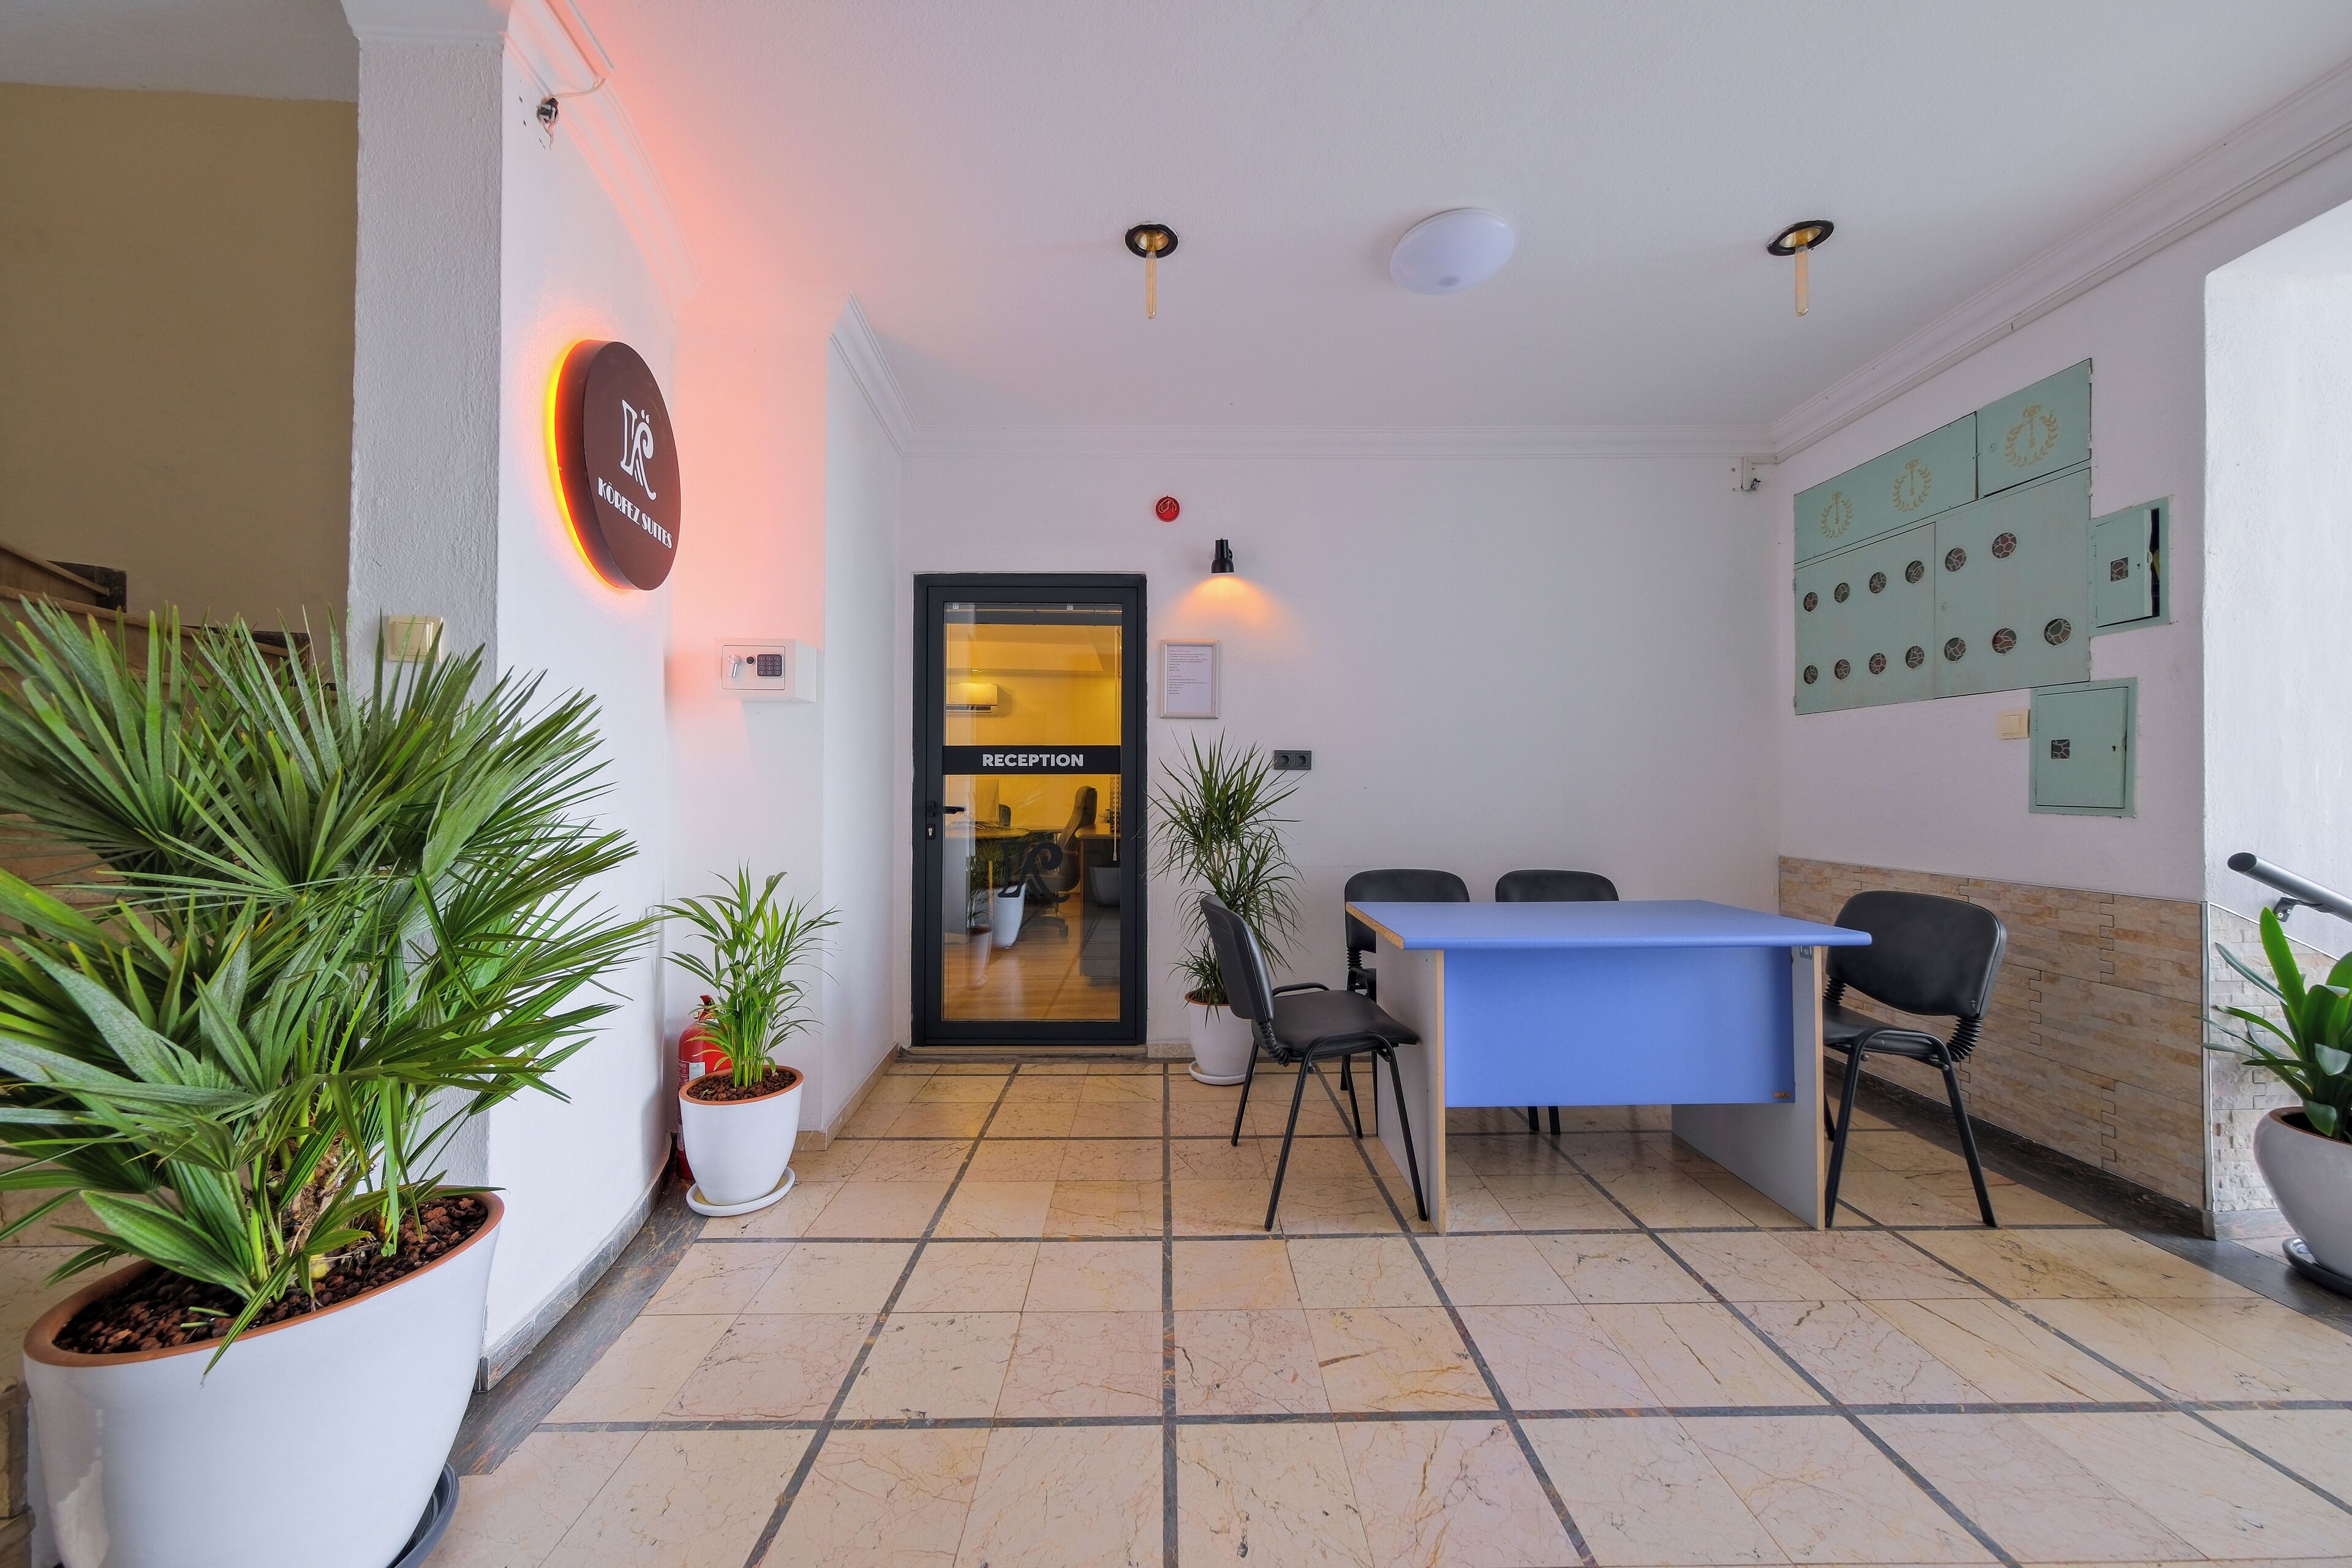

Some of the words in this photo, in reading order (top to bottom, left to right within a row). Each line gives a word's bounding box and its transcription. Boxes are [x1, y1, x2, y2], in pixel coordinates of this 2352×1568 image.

[598, 477, 641, 526] KÖRFEZ
[641, 513, 673, 549] SUITES
[982, 754, 1084, 767] RECEPTION
